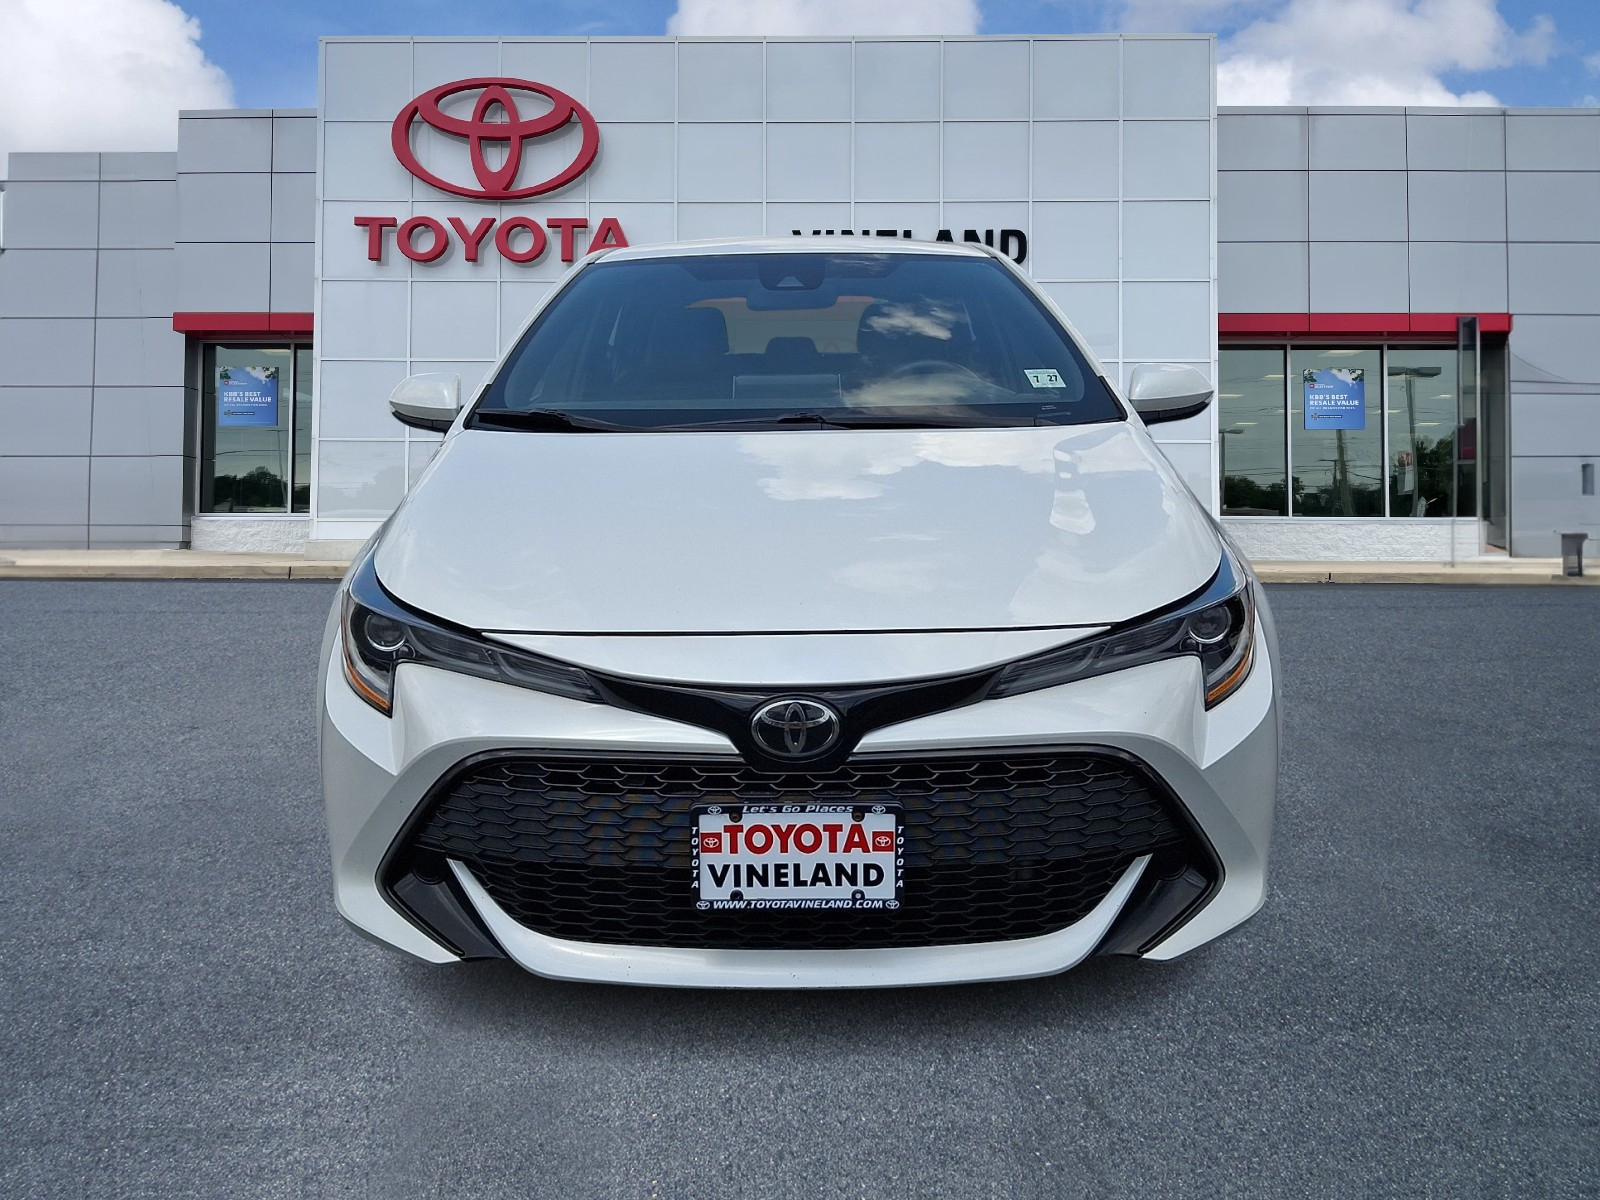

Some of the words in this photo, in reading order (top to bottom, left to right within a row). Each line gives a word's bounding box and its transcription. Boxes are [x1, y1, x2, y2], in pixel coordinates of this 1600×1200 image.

[353, 216, 630, 263] TOYOTA
[1033, 375, 1040, 383] 7
[1046, 374, 1058, 382] 27
[742, 805, 777, 813] Let's
[781, 805, 801, 813] Go
[805, 804, 854, 813] Places
[723, 823, 872, 855] TOYOTA
[706, 863, 885, 888] VINELAND
[713, 899, 884, 909] WWW.TOYOTAVINELAND.COM
